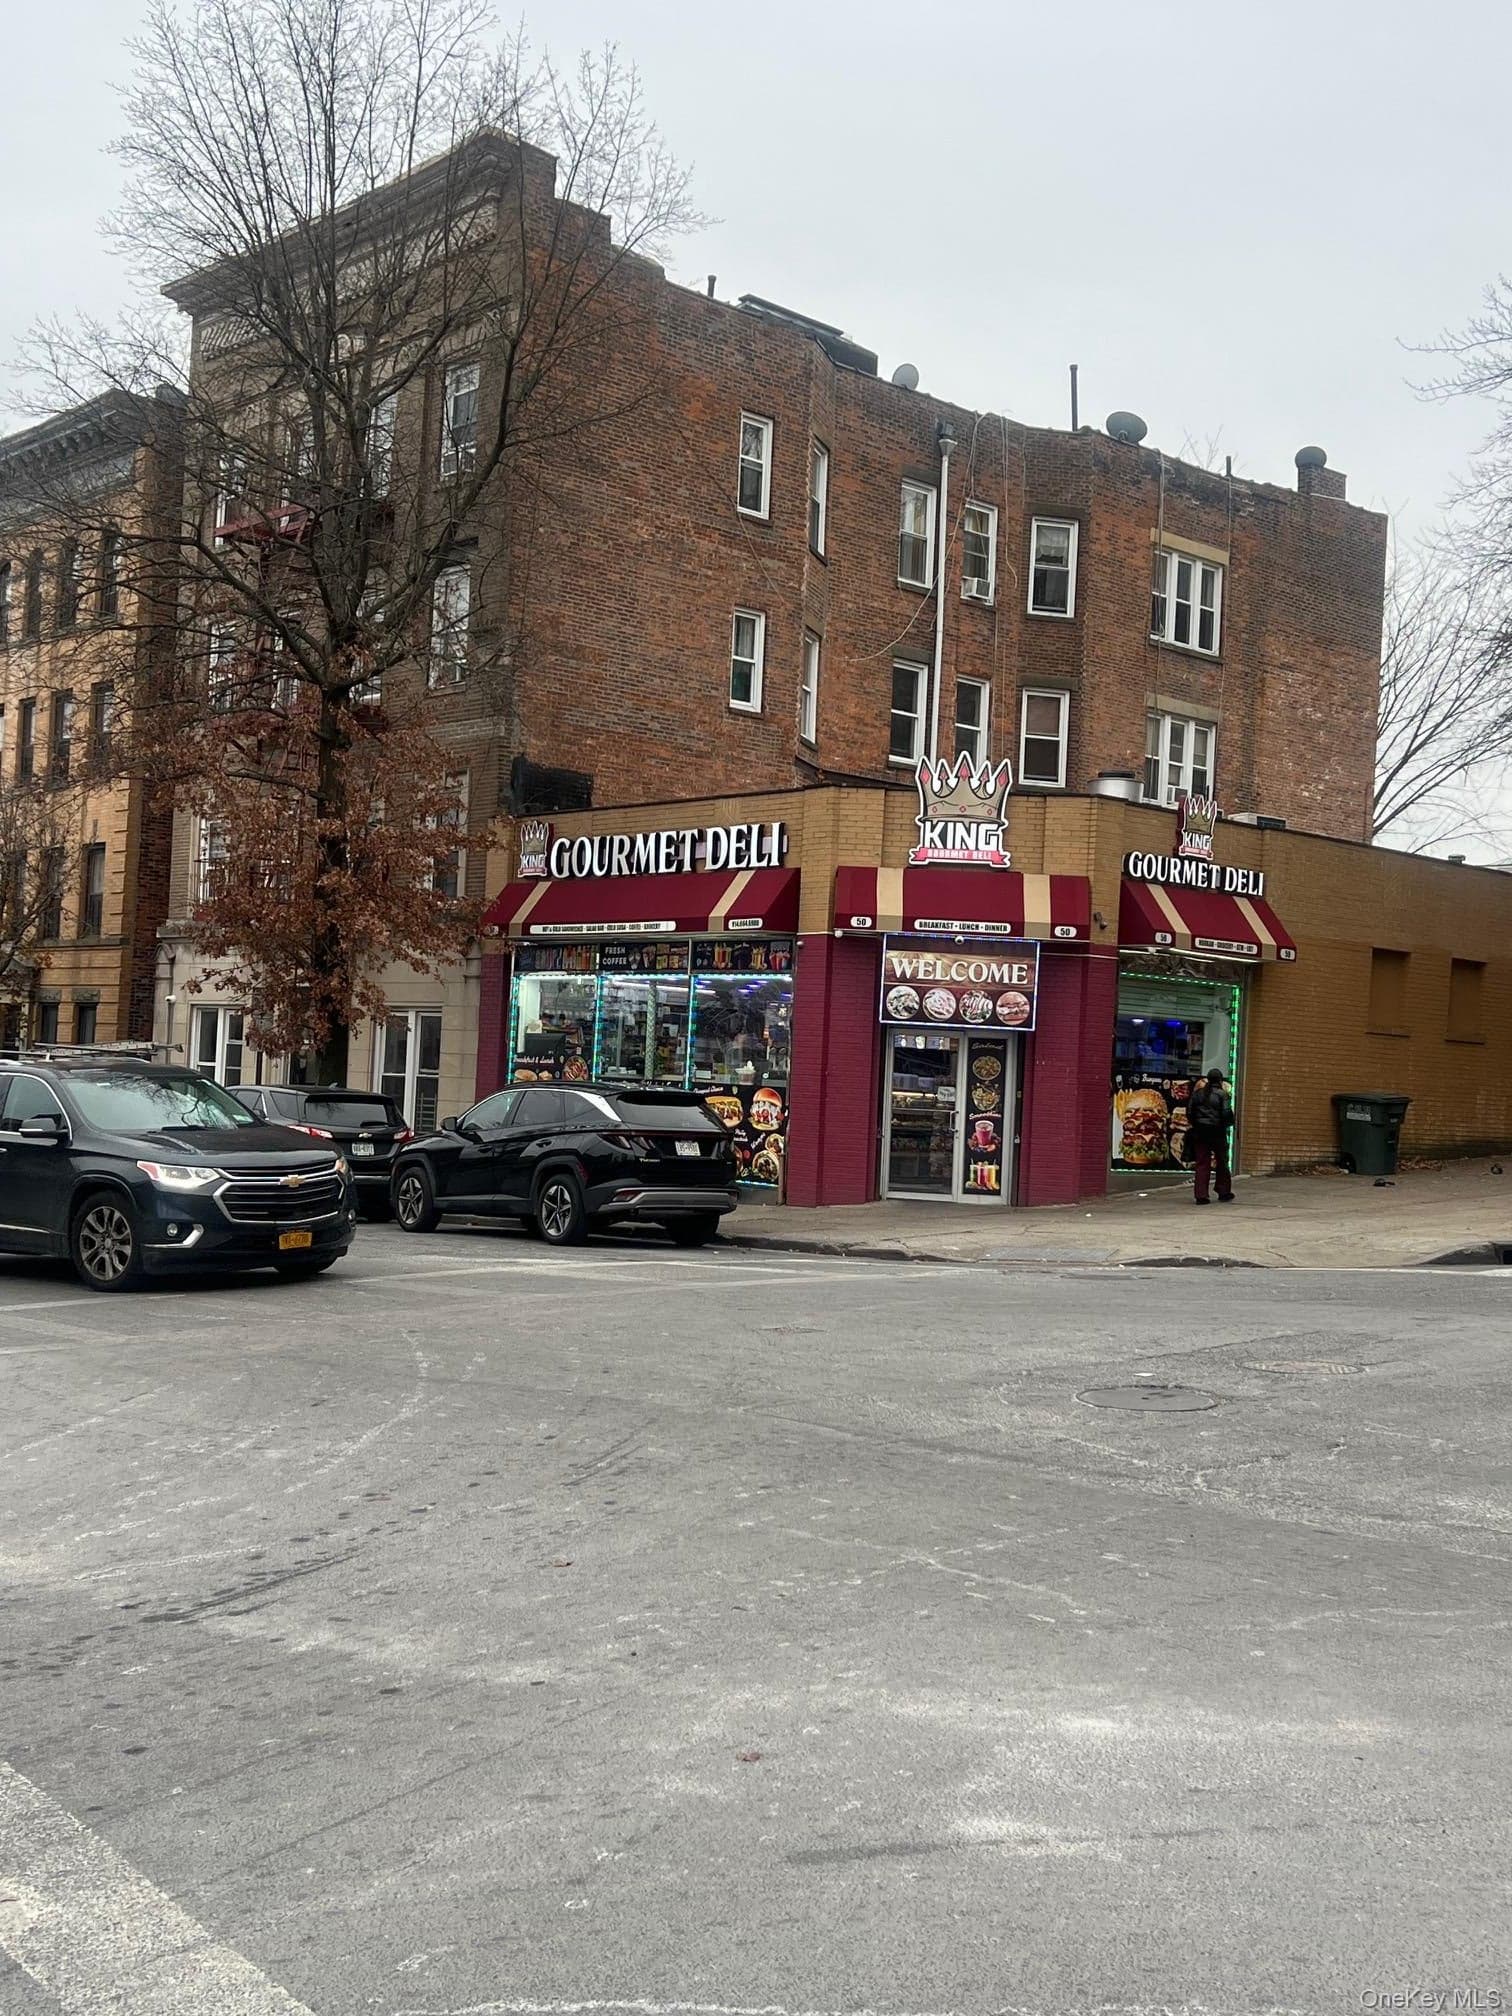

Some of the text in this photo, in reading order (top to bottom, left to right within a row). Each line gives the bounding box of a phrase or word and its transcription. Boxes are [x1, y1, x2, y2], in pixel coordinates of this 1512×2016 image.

[924, 821, 1001, 850] KING
[1183, 832, 1211, 850] KING
[550, 822, 784, 878] GOURMET DELI
[521, 854, 545, 868] KING
[1129, 851, 1264, 896] GOURMET DELI
[856, 918, 867, 926] 50
[918, 921, 1008, 932] BREAKFAST LUNCH DINNER
[1060, 928, 1071, 936] 50
[605, 946, 626, 954] FRESH
[602, 957, 627, 965] COFFEE
[891, 957, 1028, 985] WELCOME
